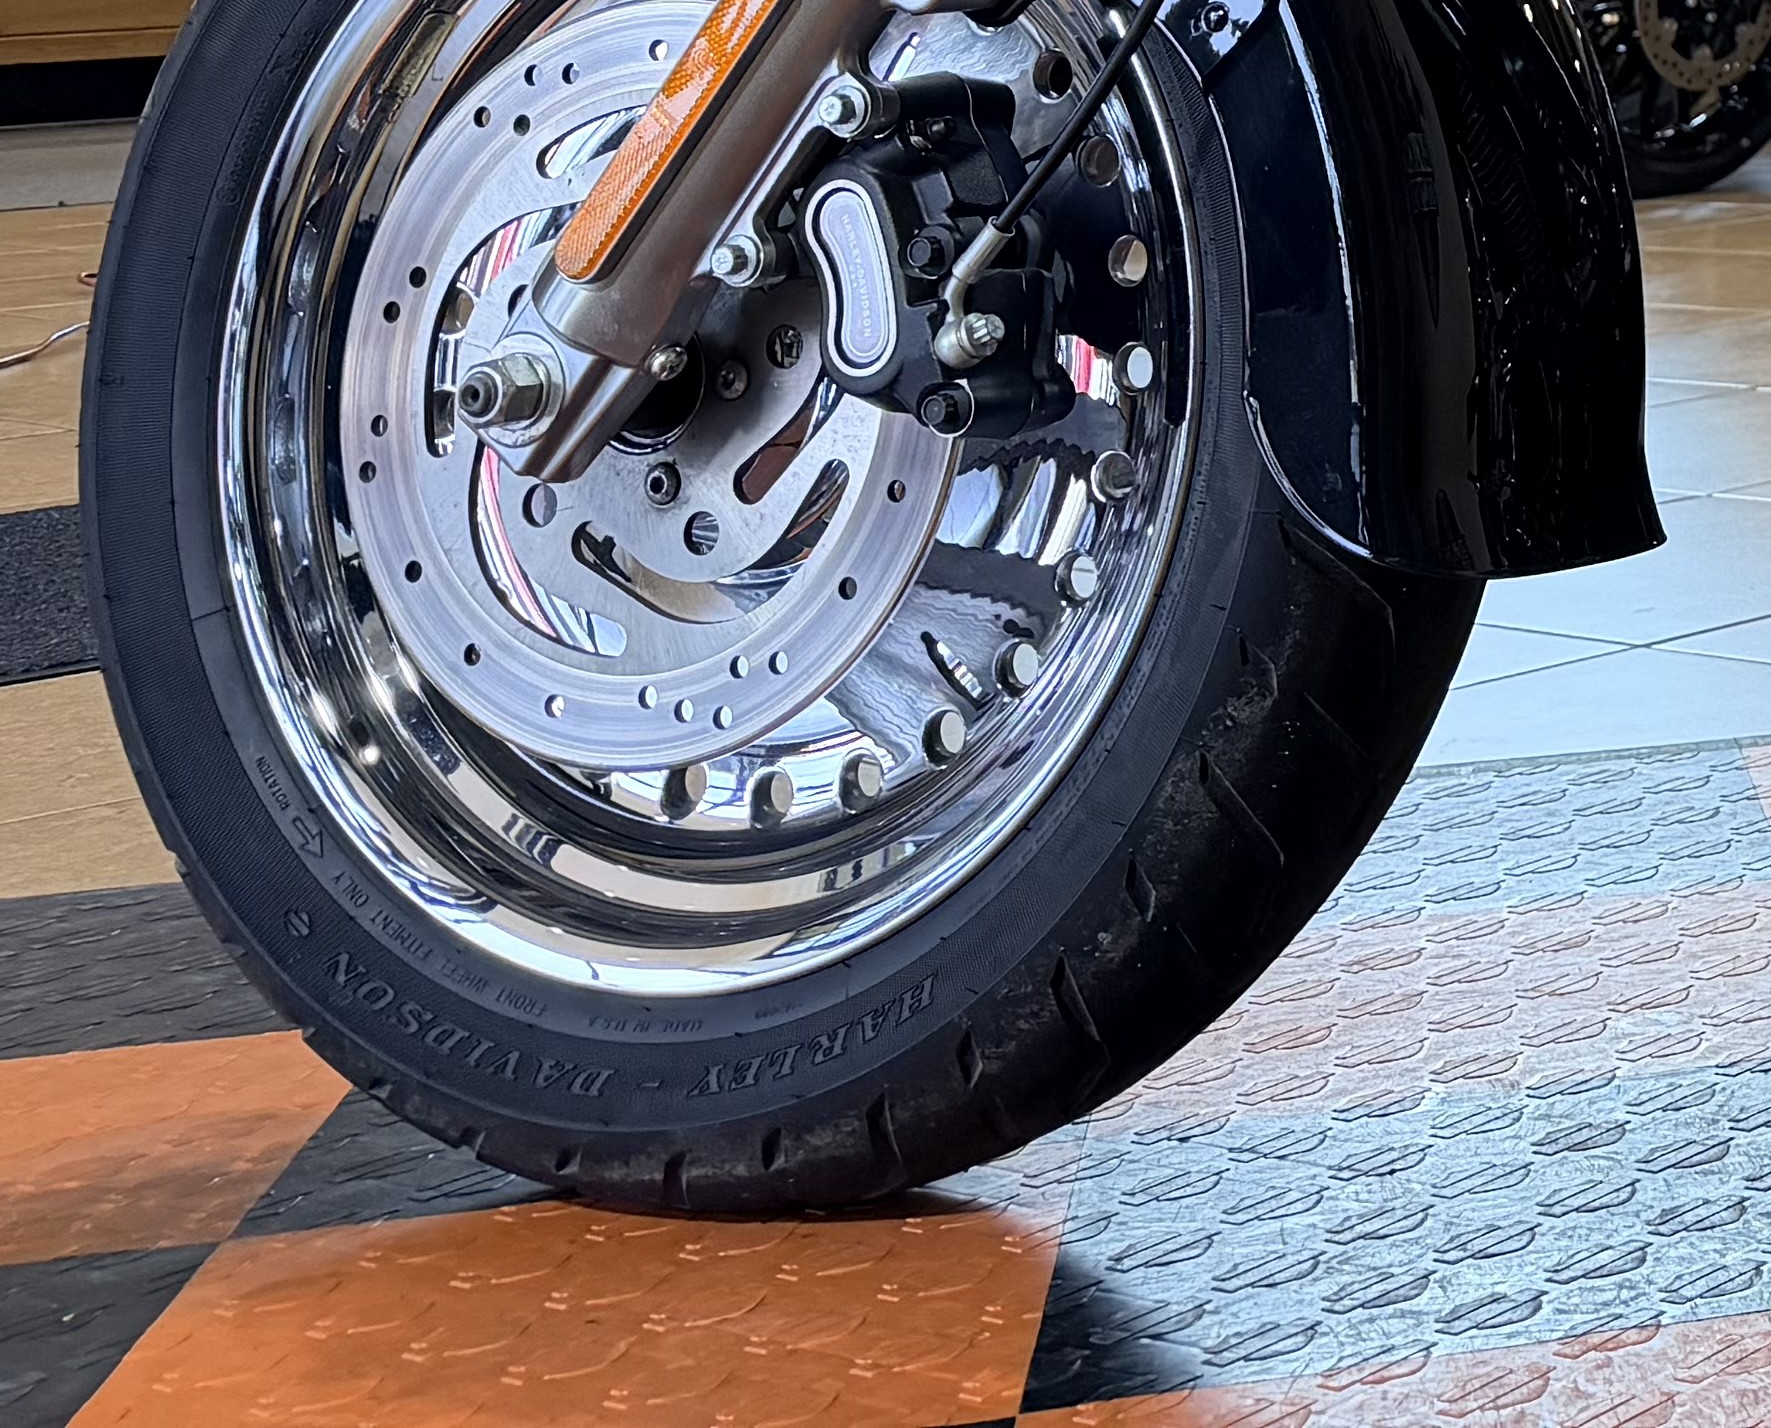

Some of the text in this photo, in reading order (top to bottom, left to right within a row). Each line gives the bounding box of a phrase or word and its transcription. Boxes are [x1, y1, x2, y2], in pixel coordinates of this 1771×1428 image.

[332, 871, 369, 910] ONLY
[371, 901, 433, 957] FITMENT
[324, 950, 616, 1099] DAVIDSON
[496, 986, 546, 1017] FRONT
[688, 973, 939, 1098] HARLEY
